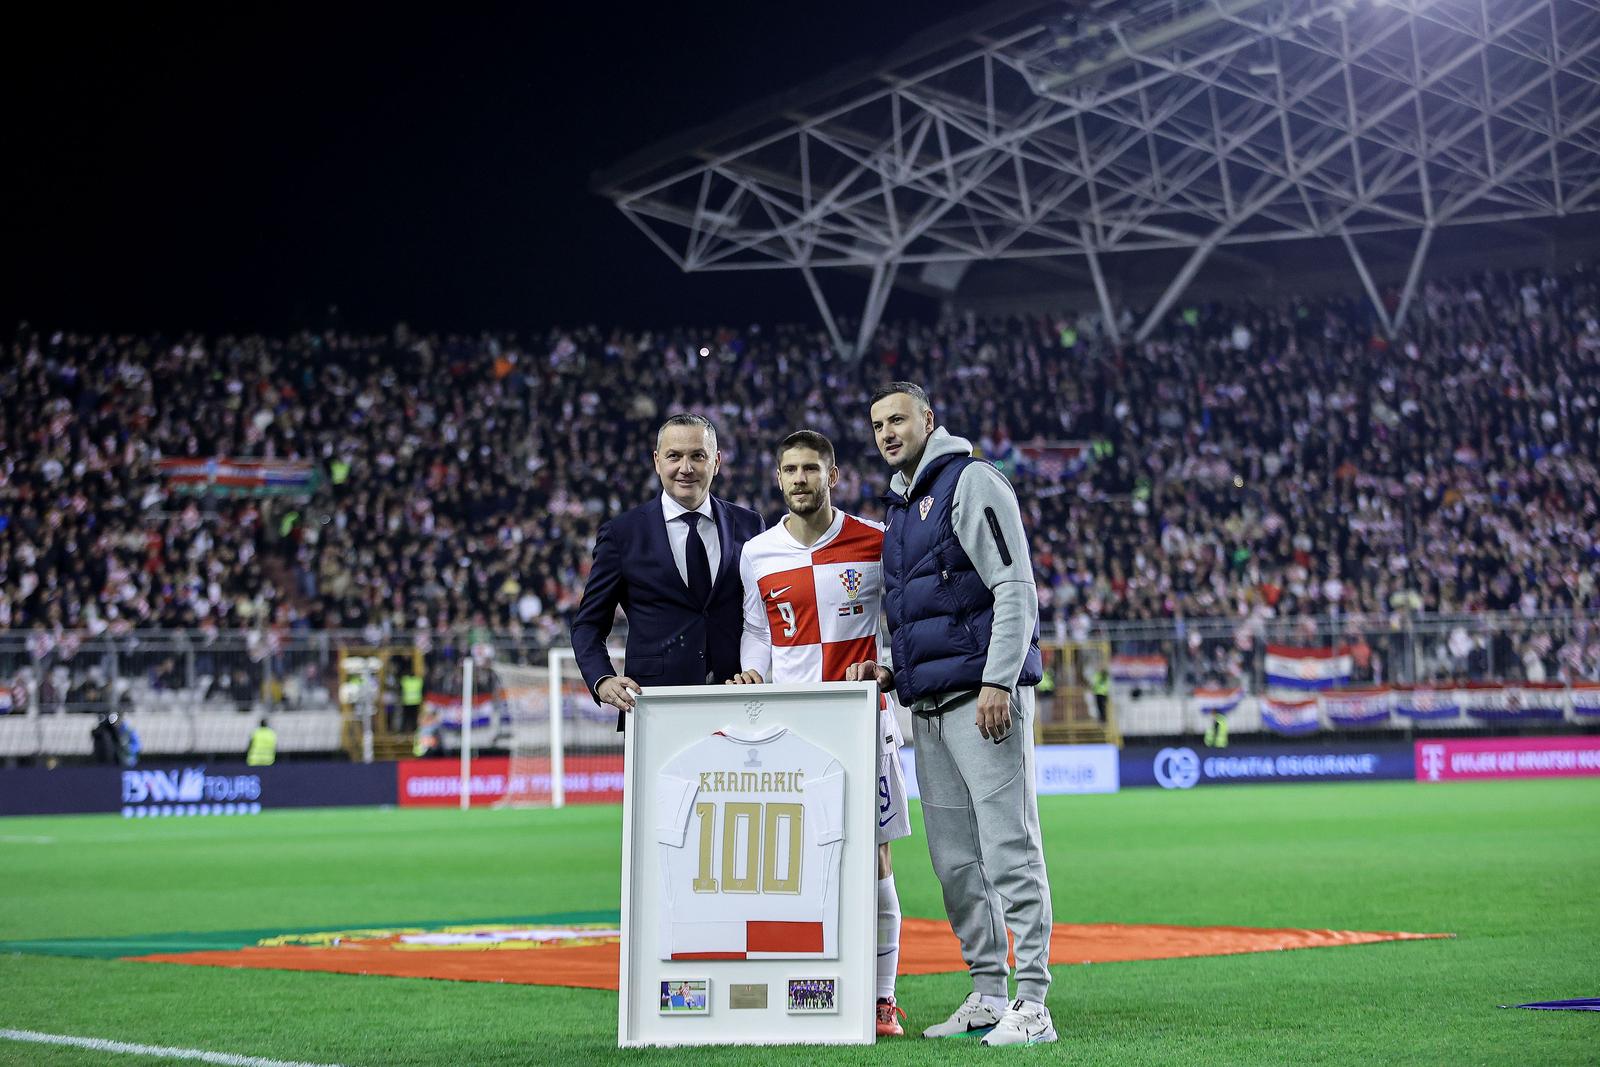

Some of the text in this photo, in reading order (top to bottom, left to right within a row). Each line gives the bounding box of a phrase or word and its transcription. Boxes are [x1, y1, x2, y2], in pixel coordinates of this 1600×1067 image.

[777, 601, 798, 638] 9
[699, 768, 805, 794] KRAMARIĆ
[1204, 753, 1374, 778] CROATIA OSIGURANJE
[204, 775, 261, 801] TOURS
[878, 775, 892, 814] 9
[692, 802, 806, 896] 100
